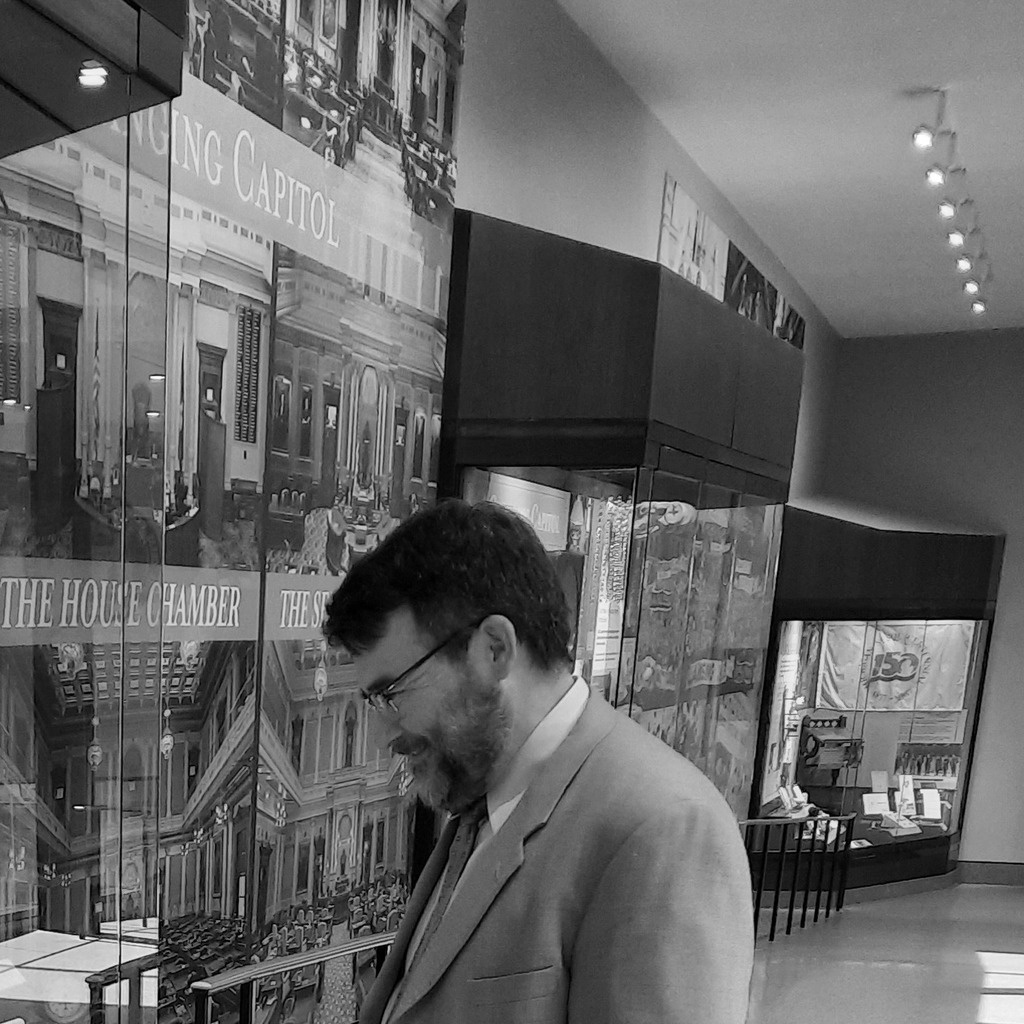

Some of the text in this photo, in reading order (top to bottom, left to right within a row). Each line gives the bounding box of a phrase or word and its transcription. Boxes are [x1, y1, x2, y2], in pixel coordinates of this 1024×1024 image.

[233, 129, 339, 248] CAPITOL
[0, 576, 241, 629] THE HOUSE CHAMBER
[280, 589, 309, 629] THE
